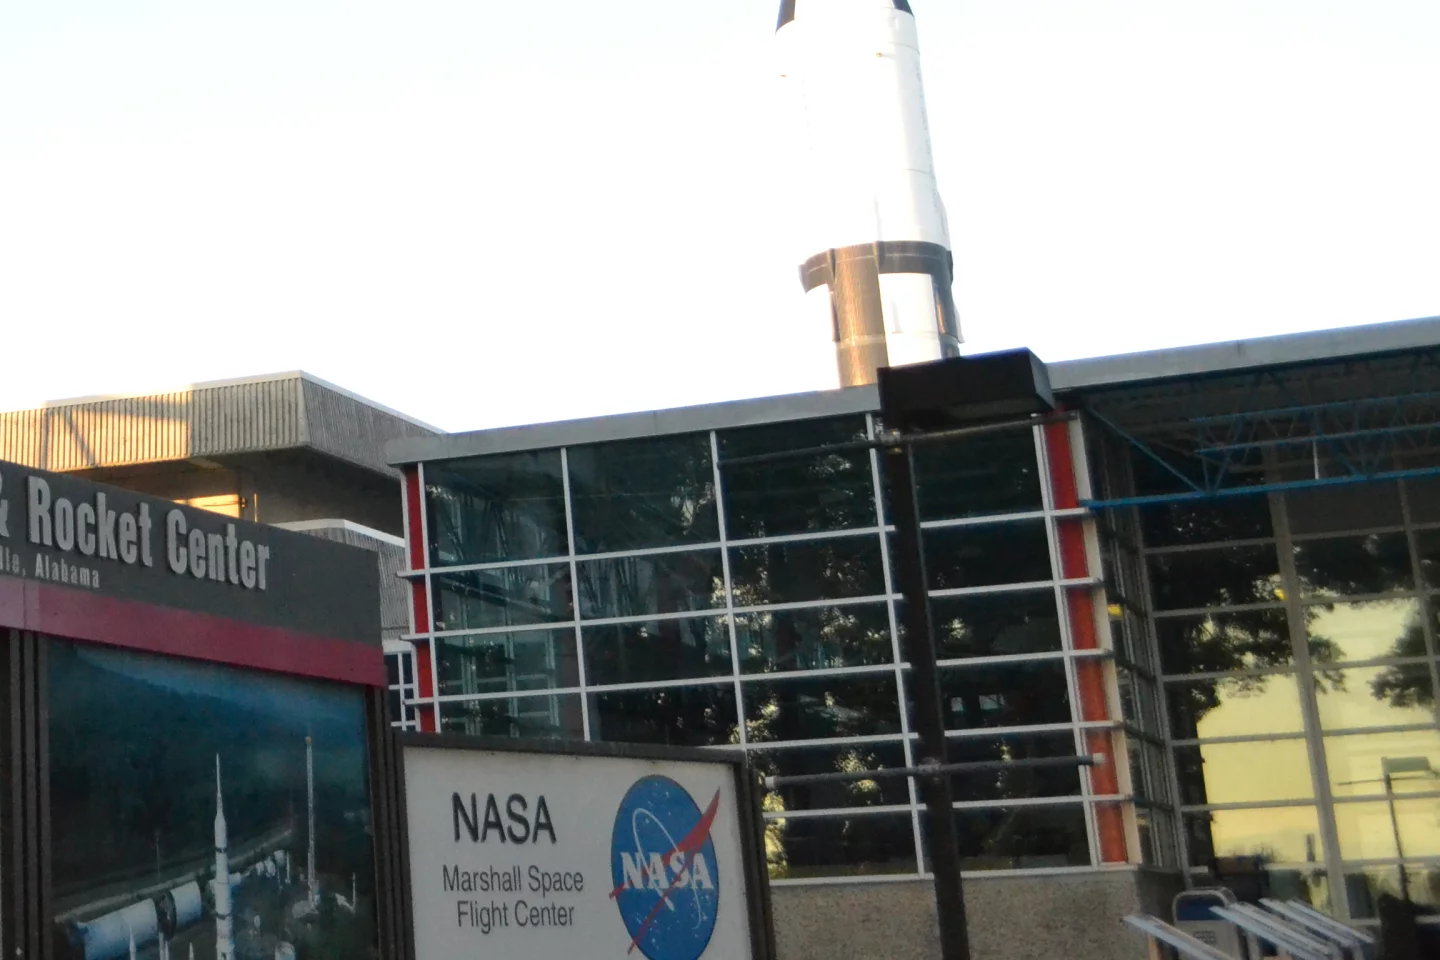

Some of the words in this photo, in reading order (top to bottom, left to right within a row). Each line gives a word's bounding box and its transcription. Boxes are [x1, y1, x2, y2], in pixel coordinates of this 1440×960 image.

[26, 475, 153, 567] Rocket
[166, 508, 270, 590] Center
[35, 553, 100, 589] Alabama
[451, 791, 557, 845] NASA
[442, 863, 521, 892] Marshall
[527, 866, 584, 899] Space
[619, 850, 714, 890] NASA
[456, 899, 509, 934] Flight
[513, 902, 575, 927] Center
